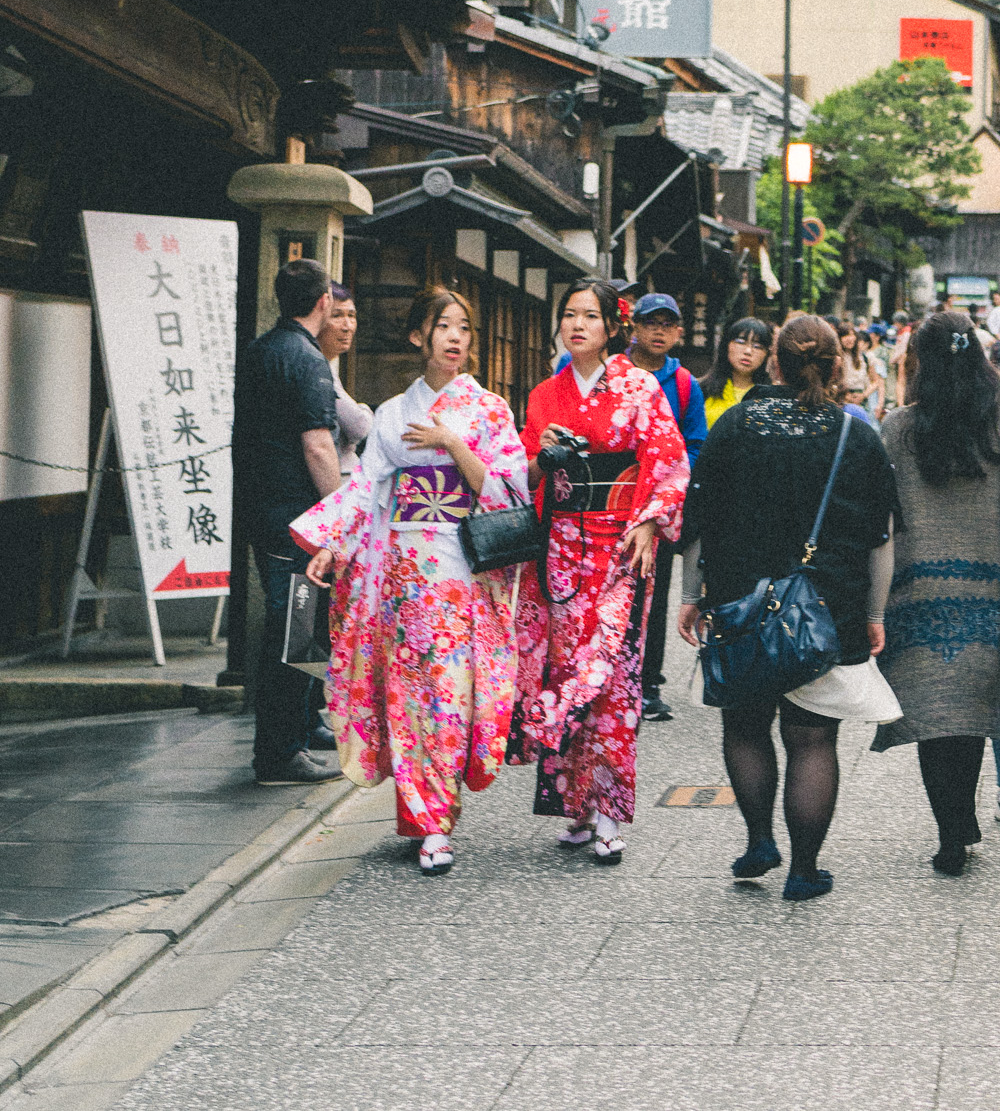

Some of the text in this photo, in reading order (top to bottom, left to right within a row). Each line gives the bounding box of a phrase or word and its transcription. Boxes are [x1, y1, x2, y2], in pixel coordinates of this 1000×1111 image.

[147, 260, 224, 546] 大日如来坐像
